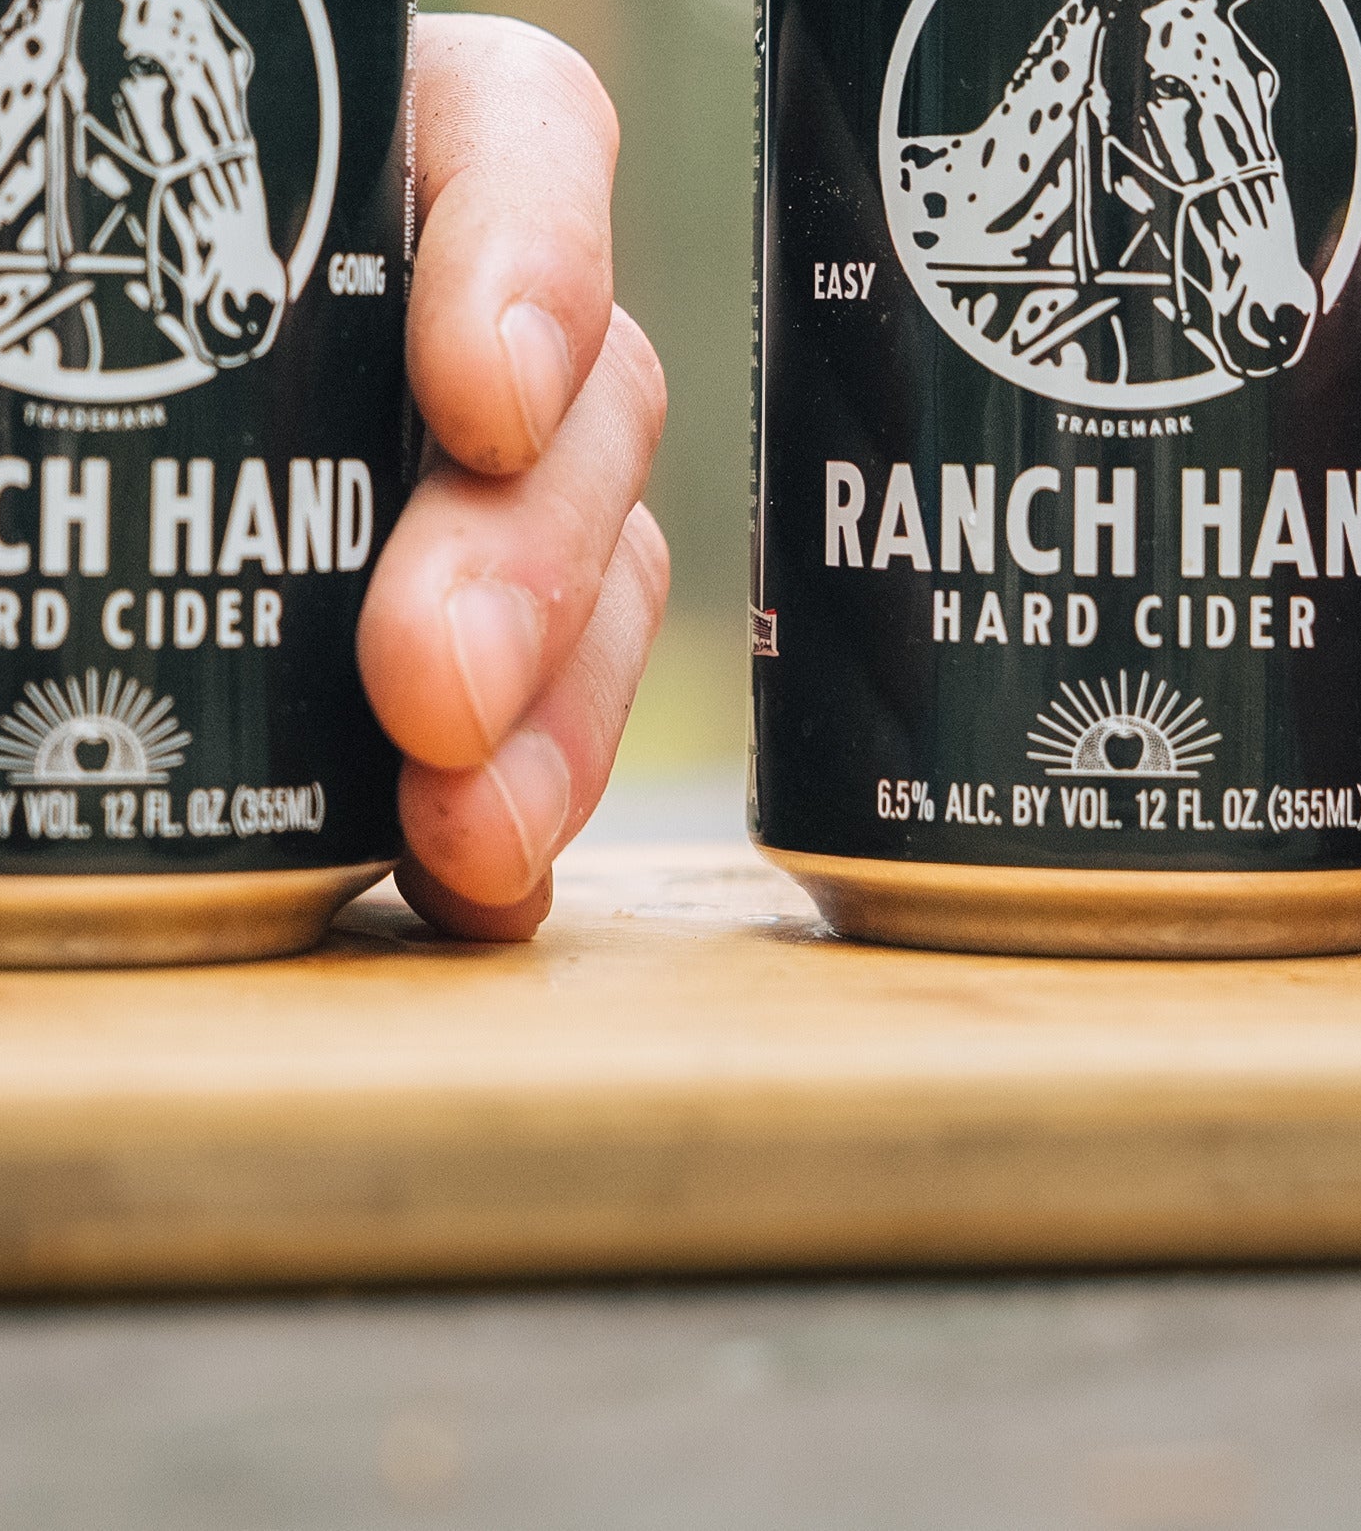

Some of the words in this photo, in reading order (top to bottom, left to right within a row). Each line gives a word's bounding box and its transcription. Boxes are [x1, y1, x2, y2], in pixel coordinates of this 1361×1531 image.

[329, 253, 386, 297] GOING
[814, 262, 876, 301] EASY
[22, 402, 167, 432] TRADEMARK
[1056, 412, 1194, 438] TRADEMARK
[150, 457, 375, 577] HAND
[824, 460, 1137, 578] RANCH
[102, 588, 282, 650] CIDER
[933, 590, 1099, 647] HARD
[1134, 595, 1316, 650] CIDER
[23, 791, 92, 840] VOL.
[101, 790, 136, 840] 12
[143, 790, 184, 840] FL.
[877, 778, 935, 823] 6.5%
[945, 783, 1002, 826] ALC.
[1013, 784, 1050, 828] BY
[1059, 787, 1122, 830] VOL.
[1136, 788, 1167, 831] 12
[1177, 788, 1215, 831] FL.
